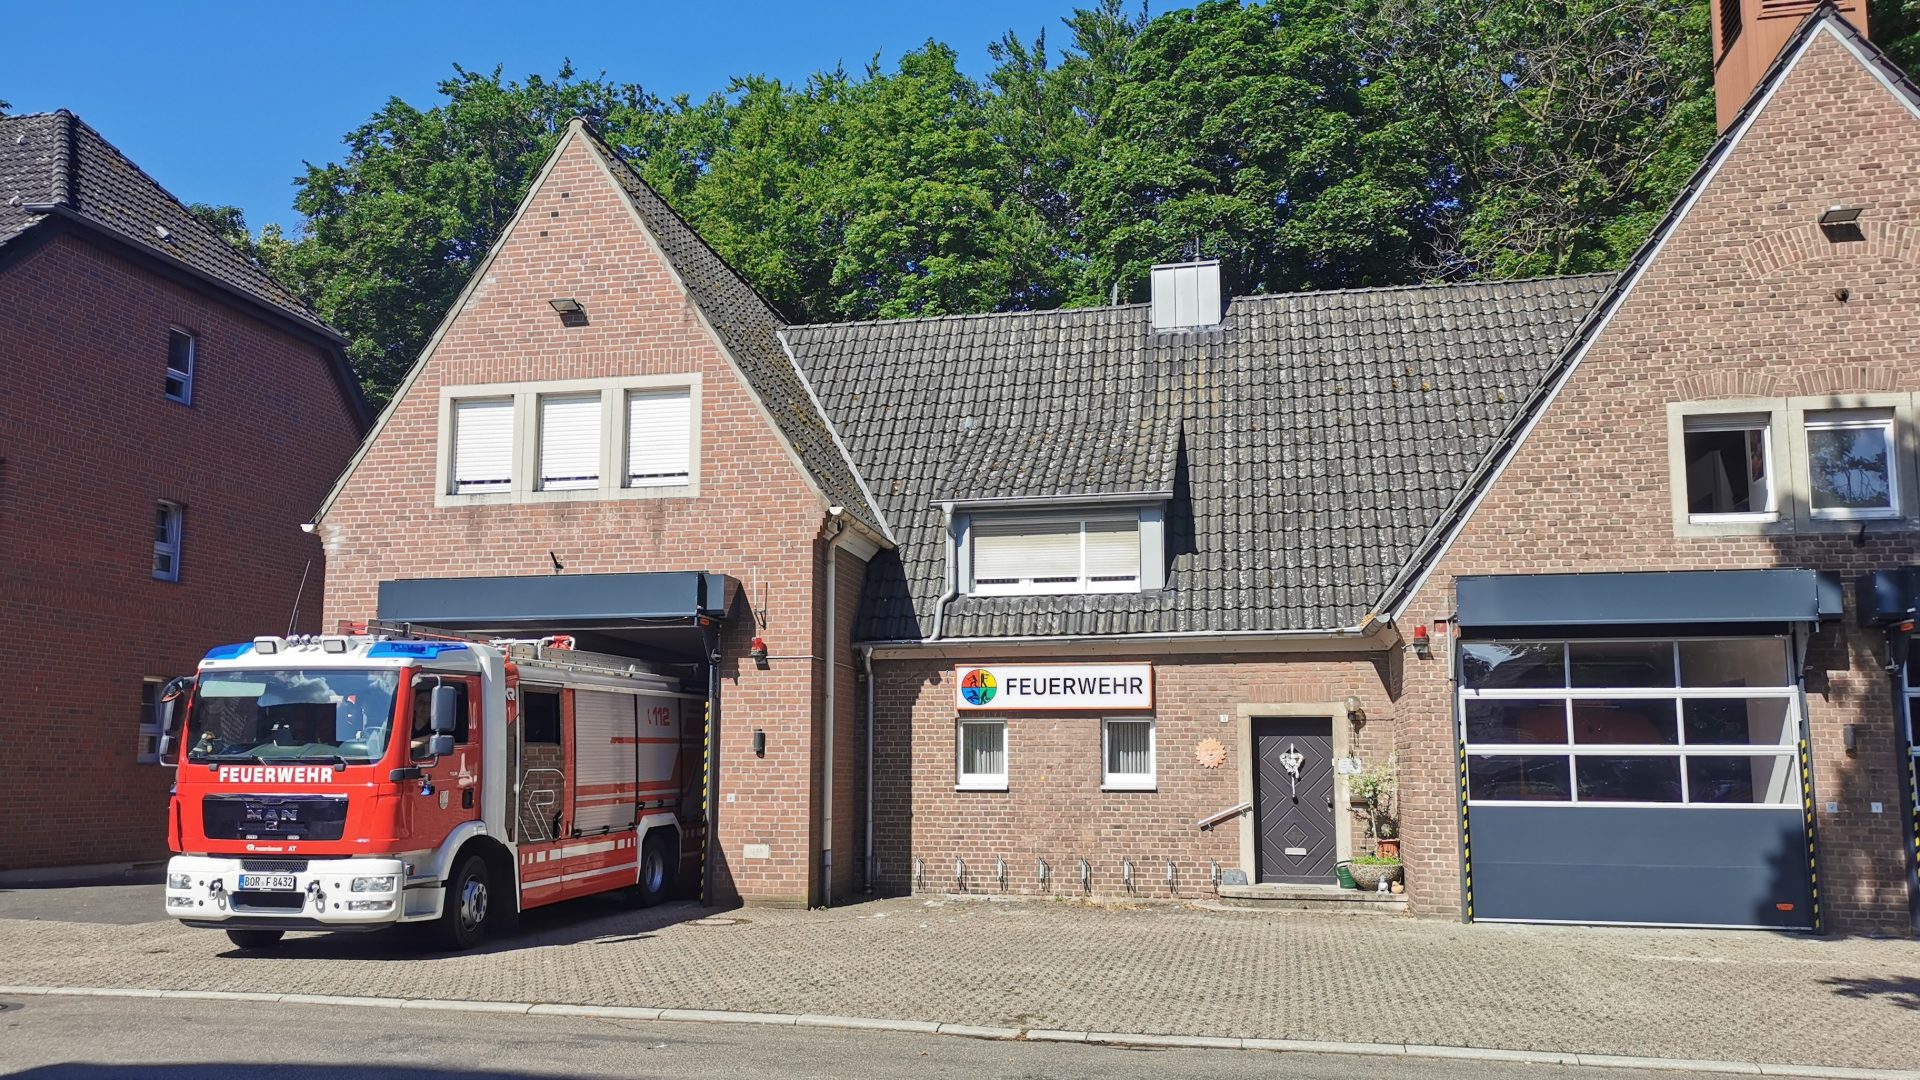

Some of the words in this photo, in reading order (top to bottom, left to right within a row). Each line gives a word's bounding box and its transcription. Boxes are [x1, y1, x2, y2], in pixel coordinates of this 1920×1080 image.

[1006, 677, 1143, 695] FEUERWEHR
[652, 706, 670, 726] 112
[219, 767, 333, 783] FEUERWEHR
[246, 809, 297, 820] MAN
[244, 876, 261, 887] BOR
[265, 877, 272, 887] F
[272, 876, 293, 887] 8432
